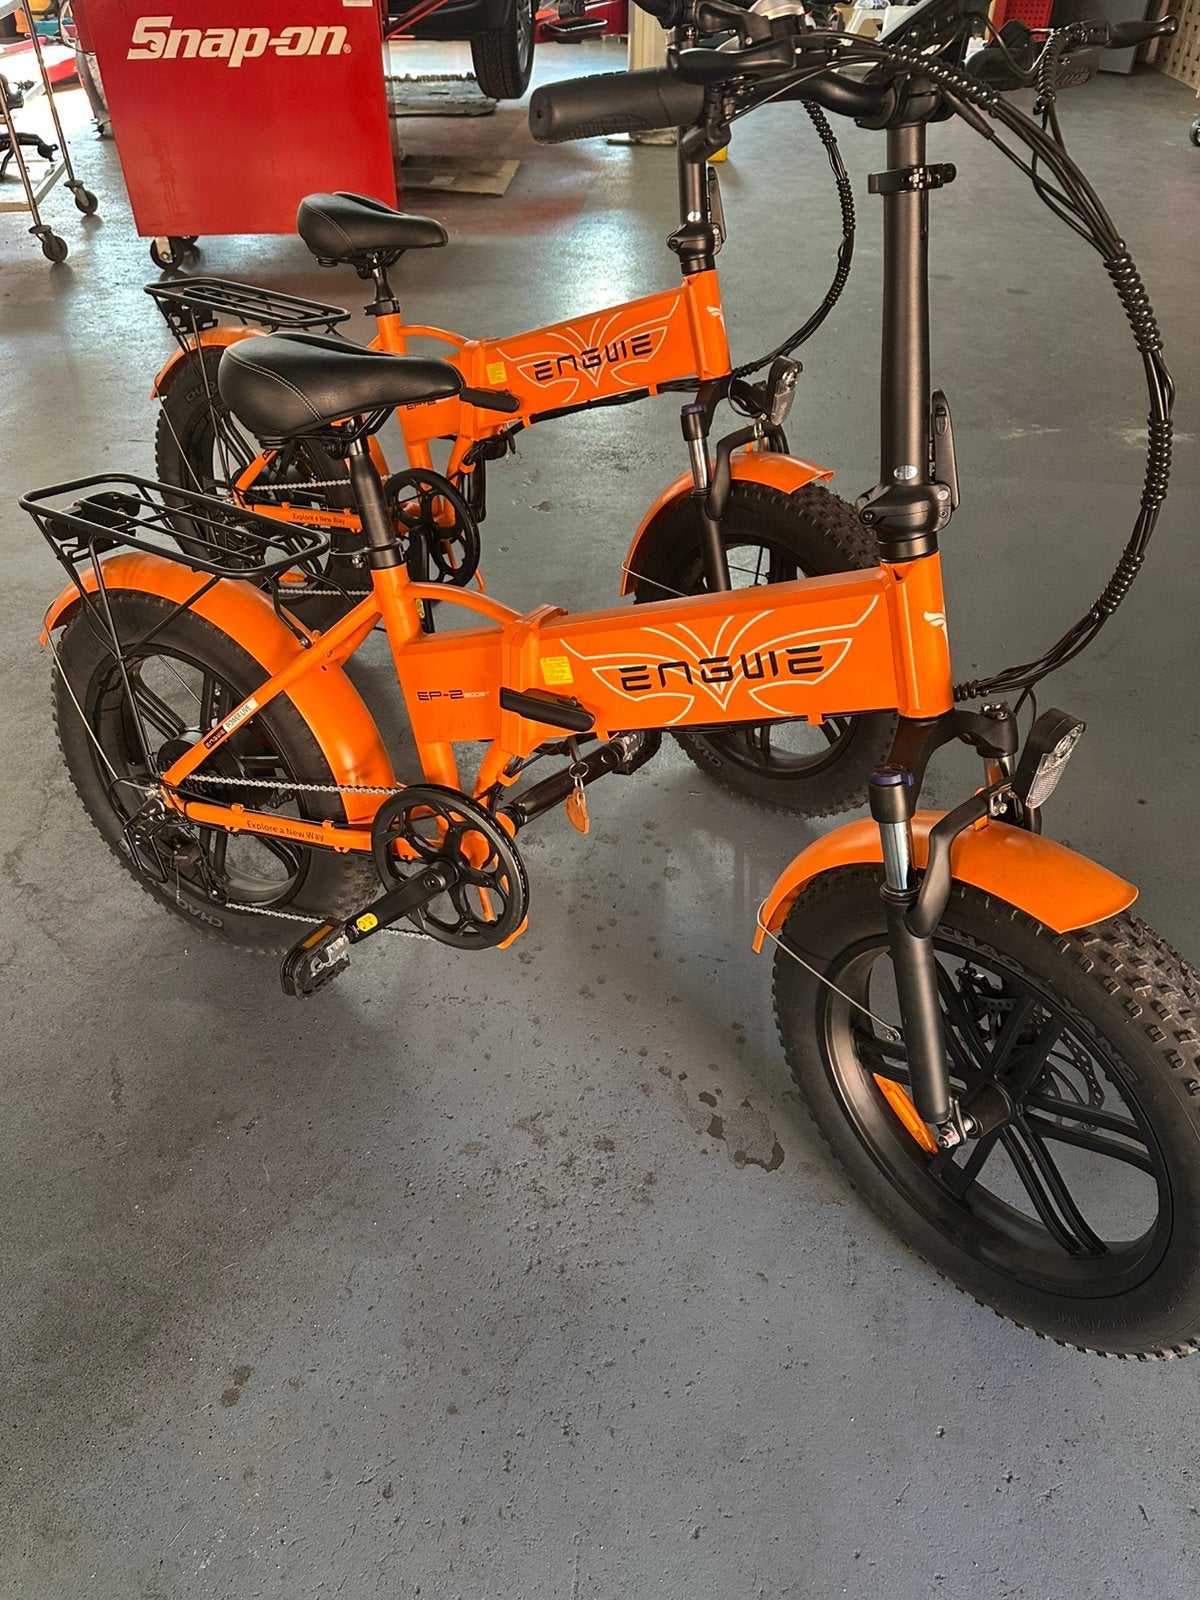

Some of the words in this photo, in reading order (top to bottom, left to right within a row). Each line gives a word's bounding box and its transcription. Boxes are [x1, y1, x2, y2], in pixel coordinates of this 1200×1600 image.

[292, 512, 314, 522] Explore
[320, 515, 333, 523] New
[333, 517, 346, 525] Way
[417, 690, 464, 701] EP-2
[246, 820, 278, 832] Explore
[279, 826, 285, 834] a
[286, 828, 305, 838] New
[306, 831, 324, 842] Way
